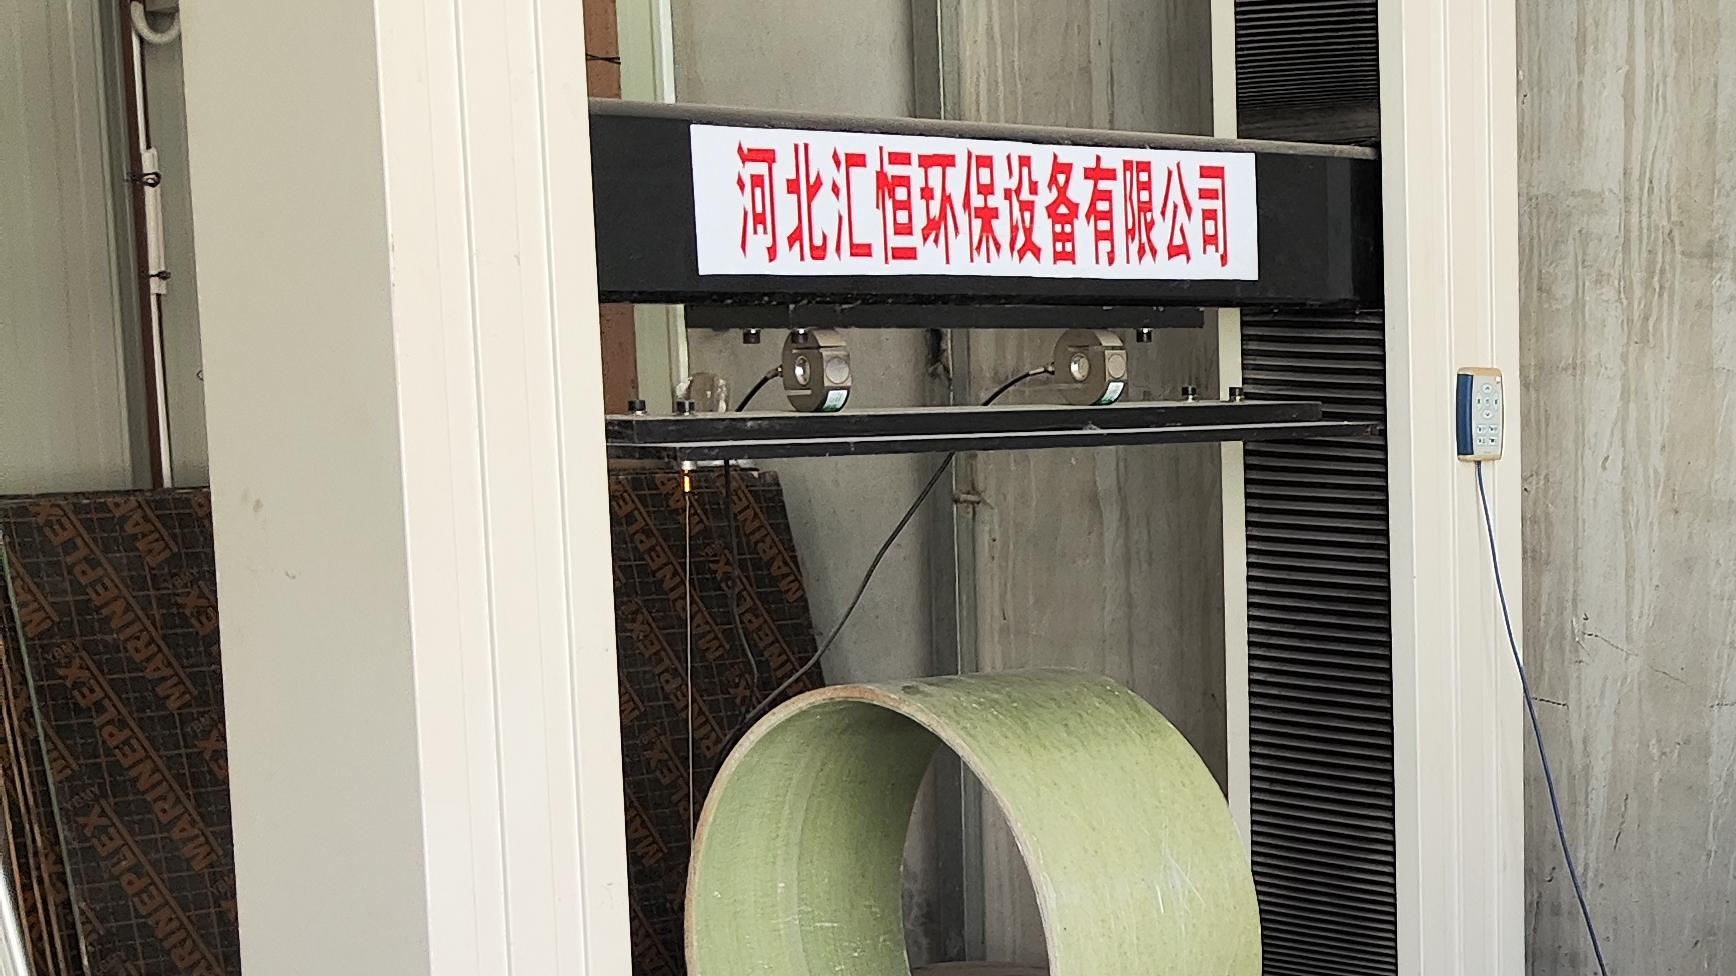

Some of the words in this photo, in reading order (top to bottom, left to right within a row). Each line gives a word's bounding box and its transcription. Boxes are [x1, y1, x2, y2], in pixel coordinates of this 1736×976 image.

[736, 140, 1228, 267] 河北汇恒环保设备有限公司
[56, 654, 219, 875] MARINEPLEX
